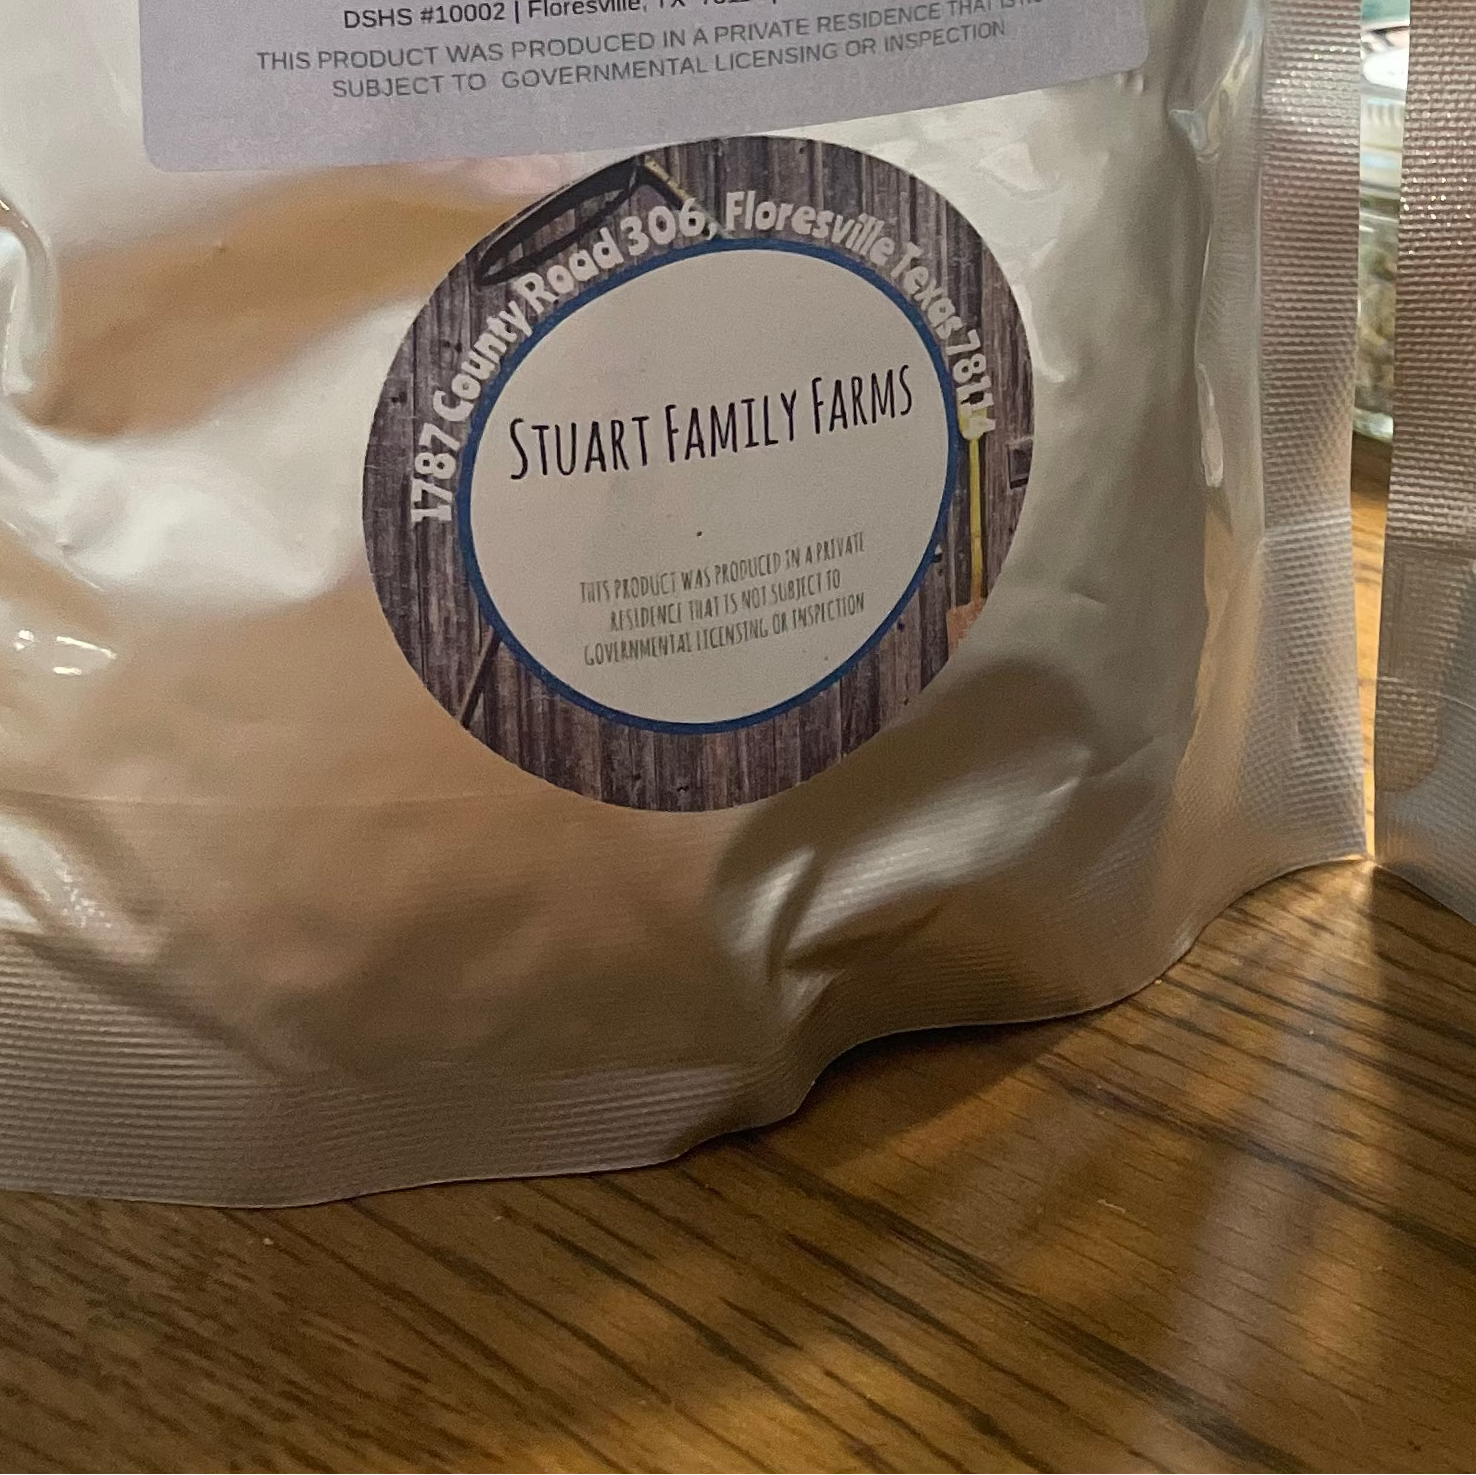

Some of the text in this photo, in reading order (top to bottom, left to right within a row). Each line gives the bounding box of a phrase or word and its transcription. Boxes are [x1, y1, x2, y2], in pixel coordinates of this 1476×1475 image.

[256, 50, 311, 71] THIS
[318, 45, 438, 70] PRODUCT
[445, 42, 504, 64] WAS
[511, 31, 655, 60] PRODUCED
[663, 28, 686, 49] IN
[693, 27, 710, 45] A
[714, 18, 811, 46] PRIVATE
[816, 2, 941, 33] RESIDENCE
[343, 7, 413, 29] DSHS
[420, 1, 506, 25] #10002
[332, 20, 1006, 99] SUBJECT TO GOVERNMENTAL LICENSING OR INSPECTION
[621, 198, 717, 255] 306,
[725, 190, 895, 265] Floresville
[513, 226, 624, 314] Road
[891, 242, 963, 339] Texas
[433, 301, 532, 421] County
[509, 364, 912, 481] STUART FAMILY FARMS
[411, 423, 460, 522] 1787
[580, 531, 865, 604] THIS PRODUCT WAS PRODUCED IN A PRIVATE
[610, 568, 841, 632] RESIDENCE THAT IS NOT SUBJECT TO
[584, 592, 865, 667] GOVERNMENTAL LICENSING OR INSPECTION
